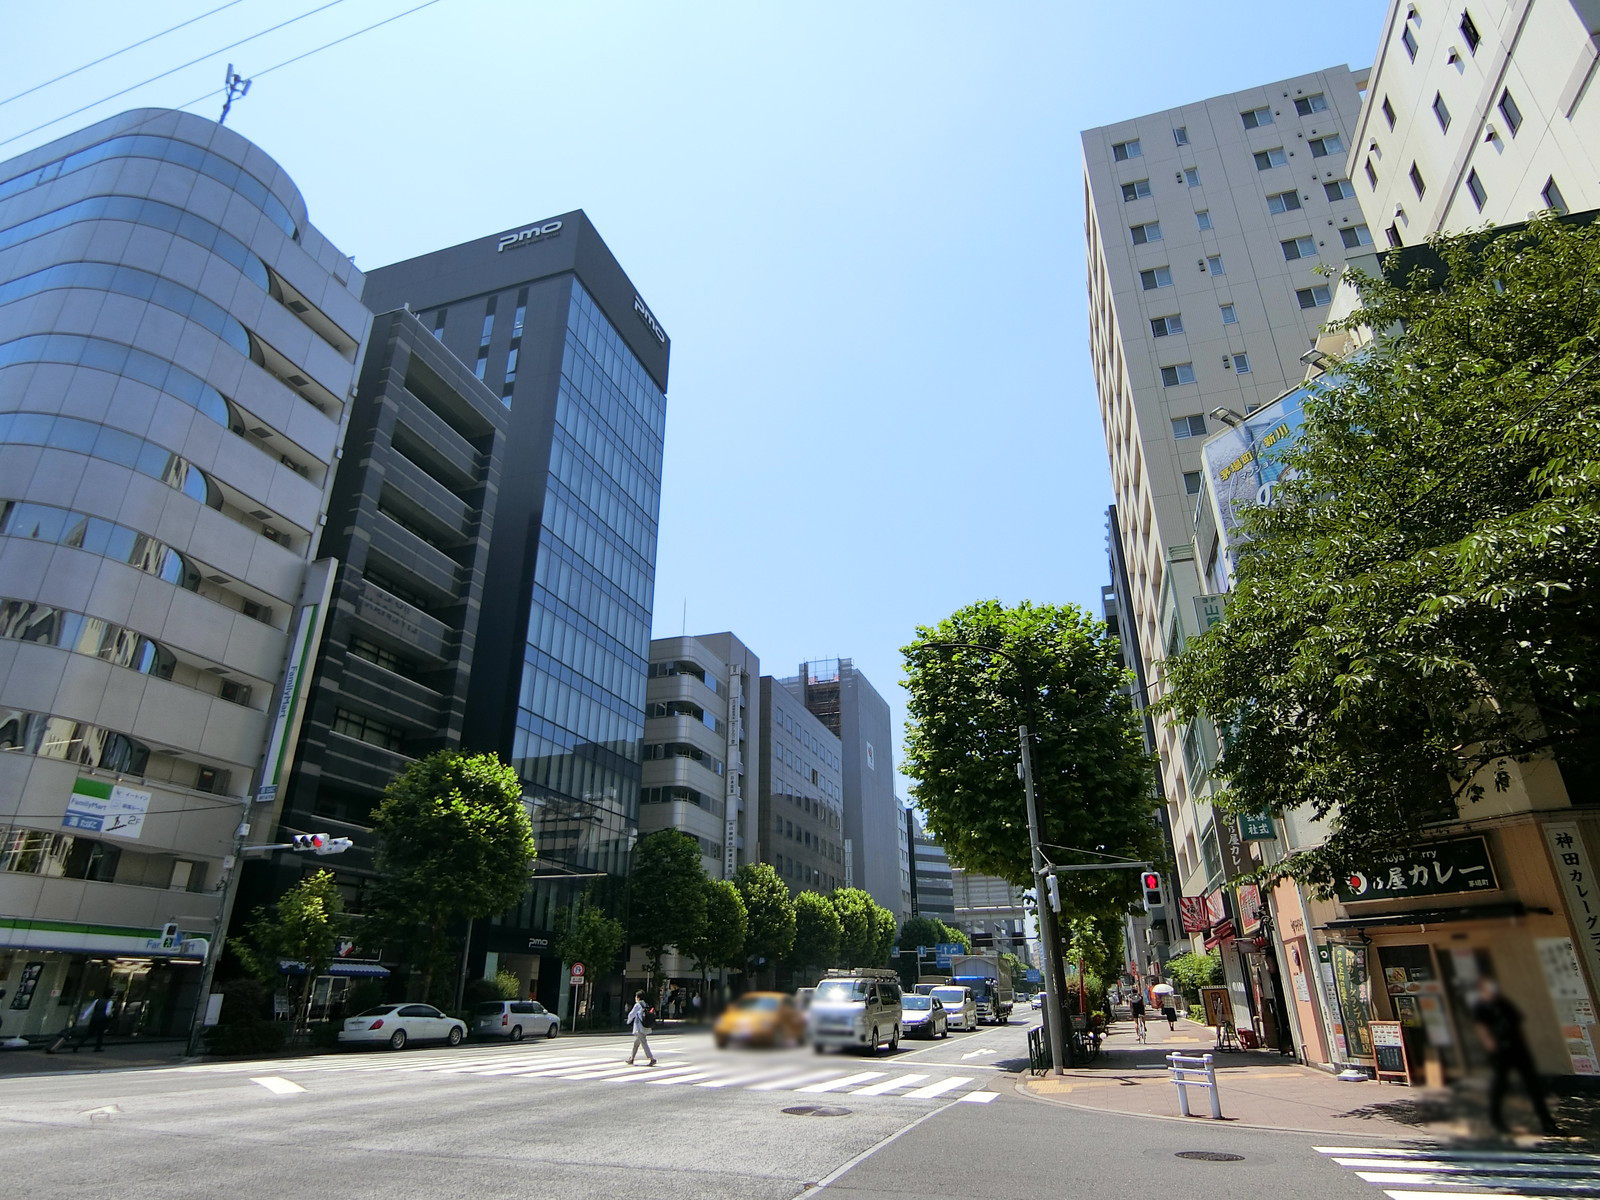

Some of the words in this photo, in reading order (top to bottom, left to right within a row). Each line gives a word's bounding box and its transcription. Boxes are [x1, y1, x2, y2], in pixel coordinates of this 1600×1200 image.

[1263, 422, 1290, 449] 新川
[280, 665, 299, 718] FamilyMart
[71, 797, 107, 811] FamilyMart
[128, 815, 142, 826] 2F
